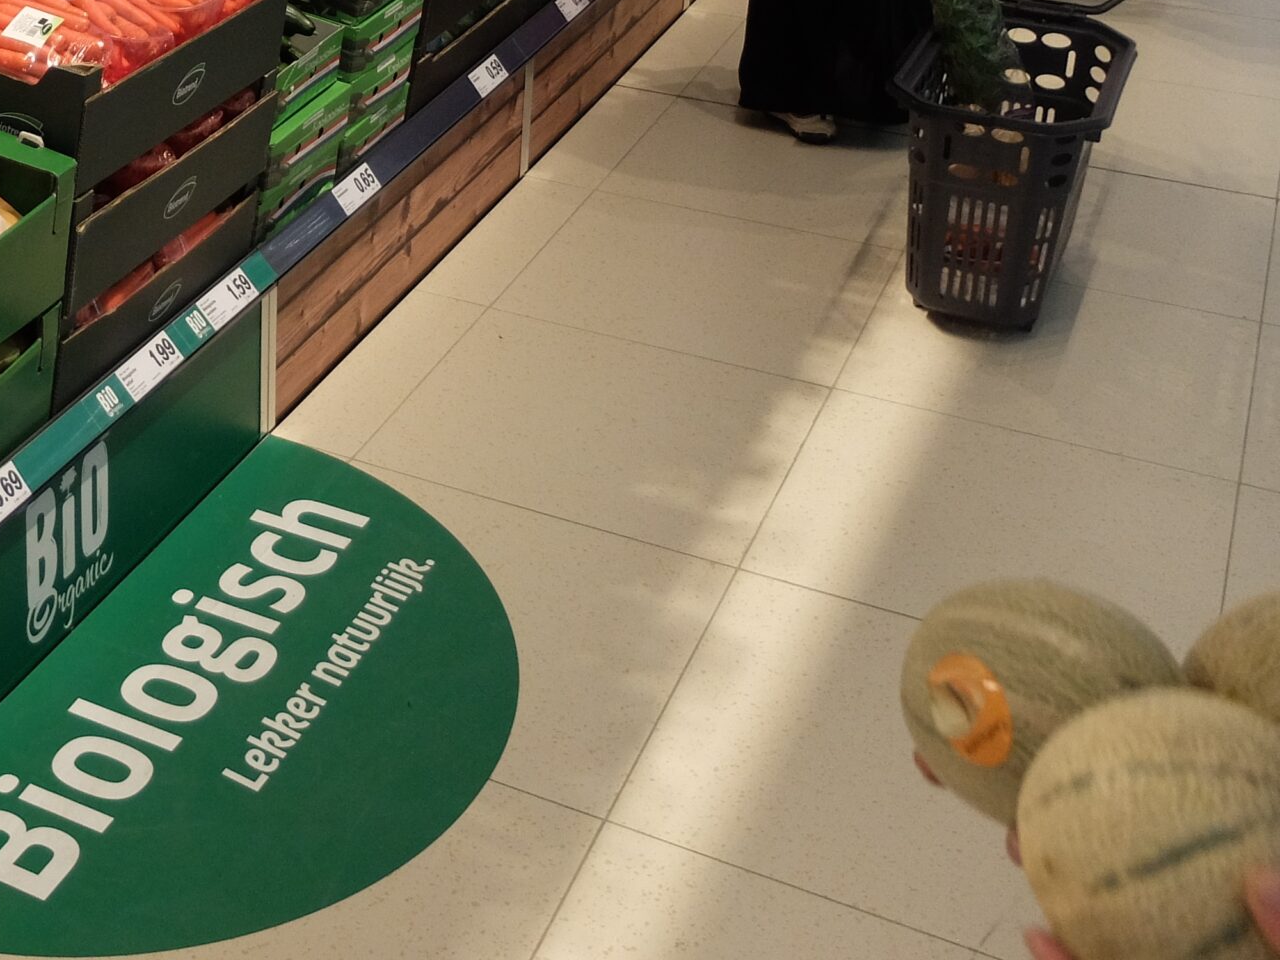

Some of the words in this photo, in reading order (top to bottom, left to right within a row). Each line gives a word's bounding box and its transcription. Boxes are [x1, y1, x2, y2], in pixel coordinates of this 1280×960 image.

[353, 167, 376, 193] 0.65
[226, 273, 252, 301] 1.59
[149, 337, 176, 368] 1.99
[222, 682, 328, 792] Lekker
[311, 555, 436, 688] natuurlijk.
